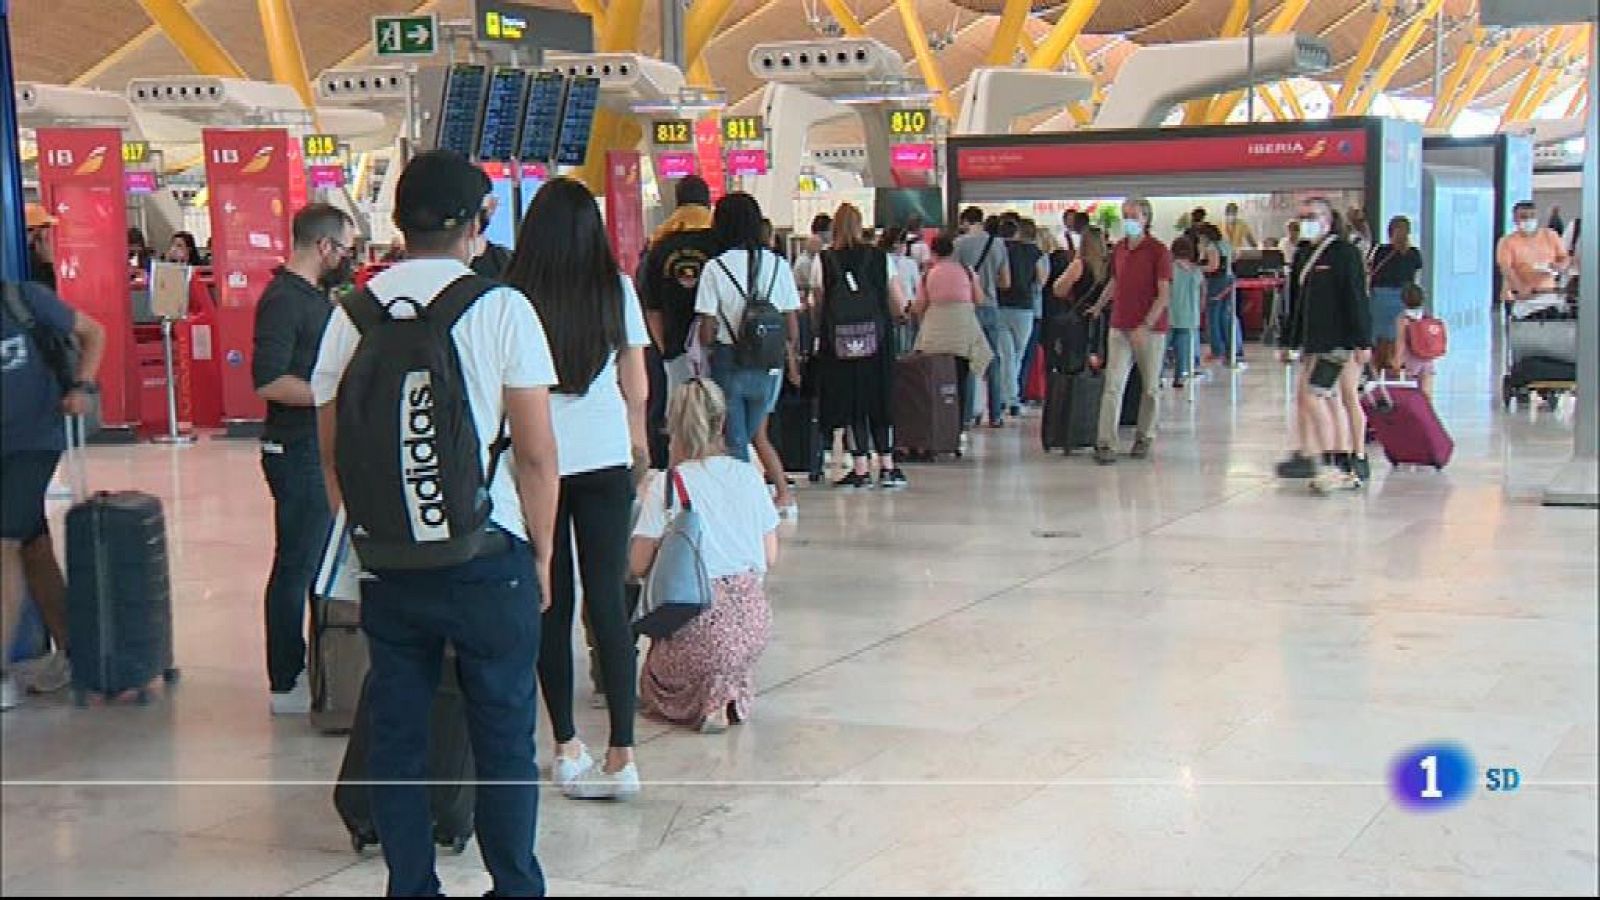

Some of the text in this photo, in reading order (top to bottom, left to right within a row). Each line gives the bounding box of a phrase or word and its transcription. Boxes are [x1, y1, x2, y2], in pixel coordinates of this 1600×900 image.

[727, 118, 756, 138] 811
[891, 111, 926, 132] 810
[657, 124, 688, 141] 812
[213, 149, 239, 164] IB
[1247, 142, 1304, 154] IBERIA
[48, 149, 73, 166] IB
[405, 386, 445, 525] adidas
